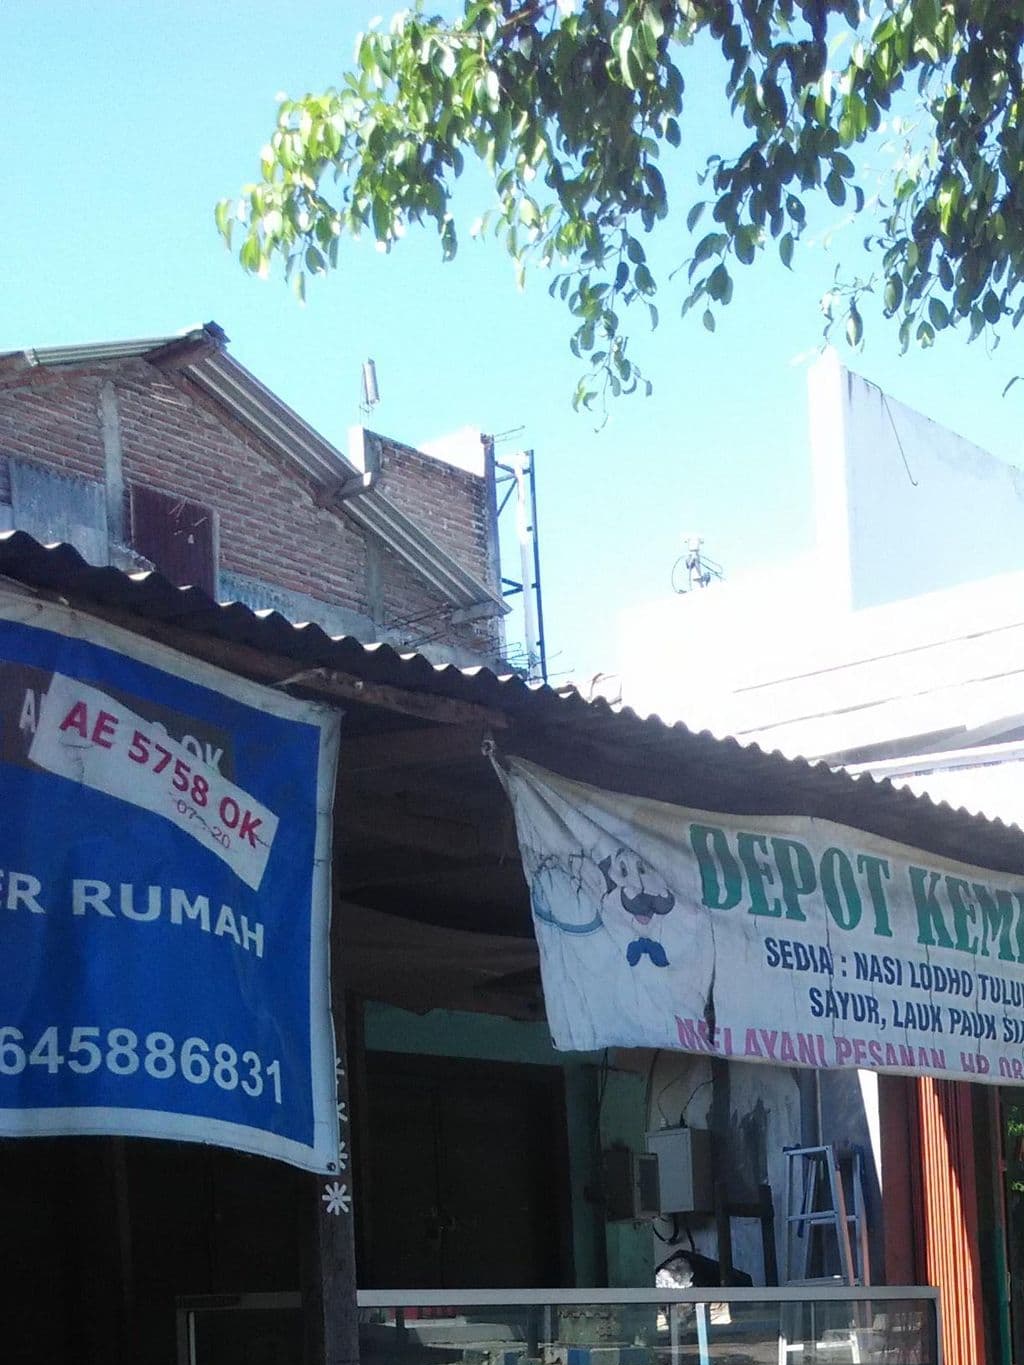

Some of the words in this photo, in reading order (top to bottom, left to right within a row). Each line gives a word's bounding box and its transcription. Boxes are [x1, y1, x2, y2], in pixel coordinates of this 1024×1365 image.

[59, 700, 119, 750] AE
[127, 729, 210, 808] 5758
[218, 796, 263, 850] OK
[71, 878, 265, 959] RUMAH
[689, 822, 893, 938] DEPOT
[764, 936, 835, 976] SEDIA
[853, 951, 903, 986] NASI
[908, 959, 973, 998] LODHO
[808, 986, 887, 1031] SAYUR,
[892, 999, 943, 1034] LAUK
[0, 1025, 283, 1106] 645886831
